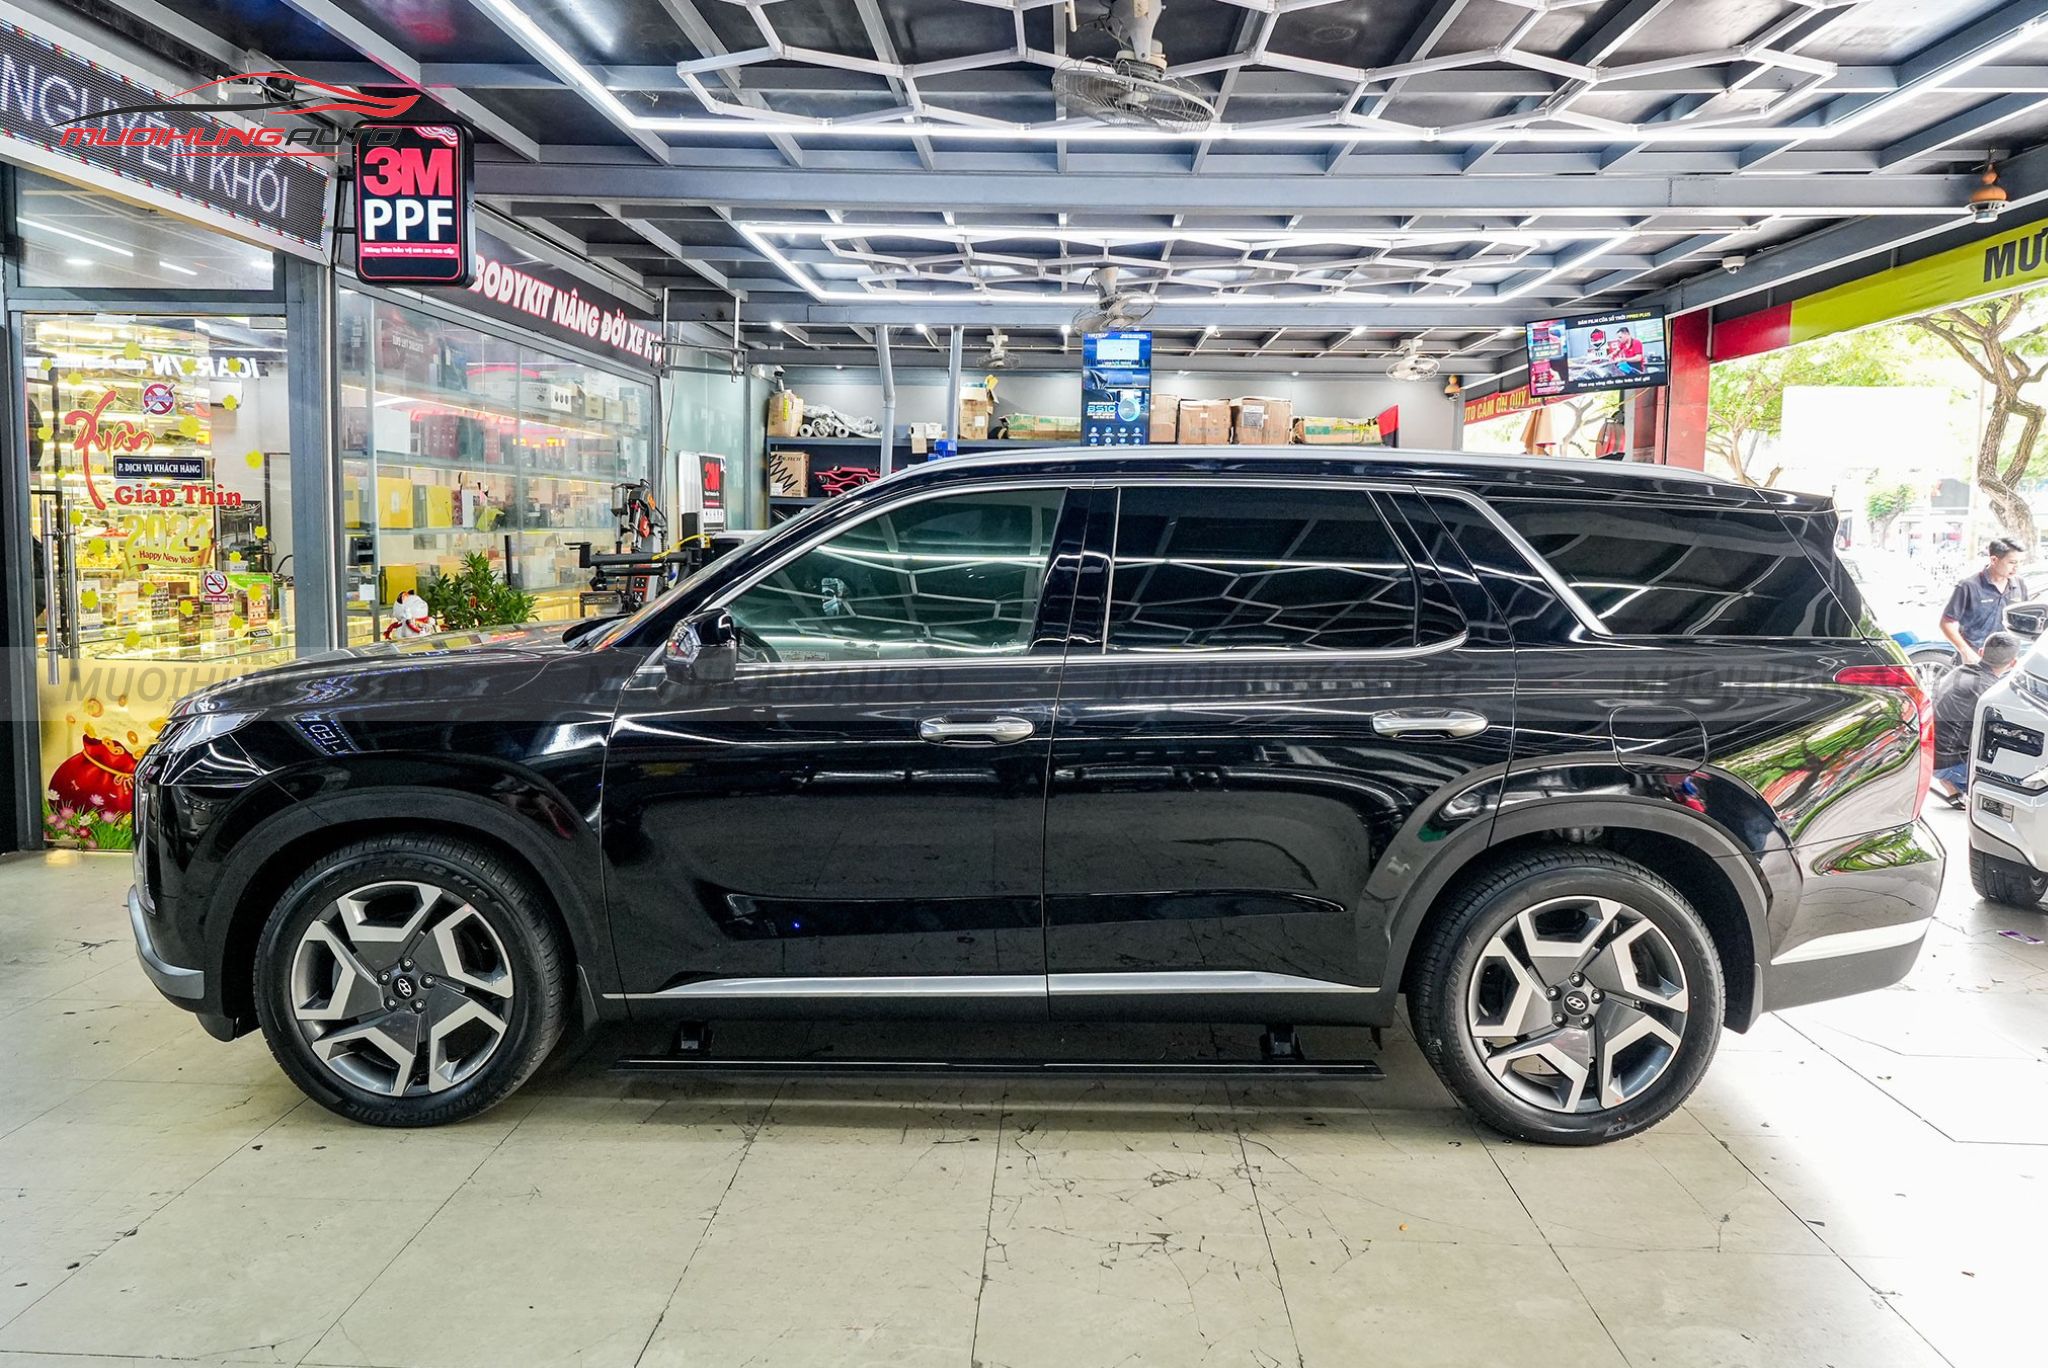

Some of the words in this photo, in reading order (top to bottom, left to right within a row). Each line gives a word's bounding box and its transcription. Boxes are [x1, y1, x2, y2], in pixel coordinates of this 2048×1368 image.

[363, 147, 453, 196] 3M
[364, 199, 453, 241] PPF
[1983, 226, 2048, 283] MƯ
[467, 253, 554, 320] BODYKIT
[552, 287, 600, 339] NÂNG
[625, 322, 645, 356] XE
[125, 463, 142, 474] DỊCH
[154, 460, 179, 473] KHÁCH
[179, 462, 201, 474] HÀNG
[123, 514, 212, 553] 2024
[139, 550, 162, 561] Happy
[162, 553, 179, 564] New
[179, 555, 195, 564] Year
